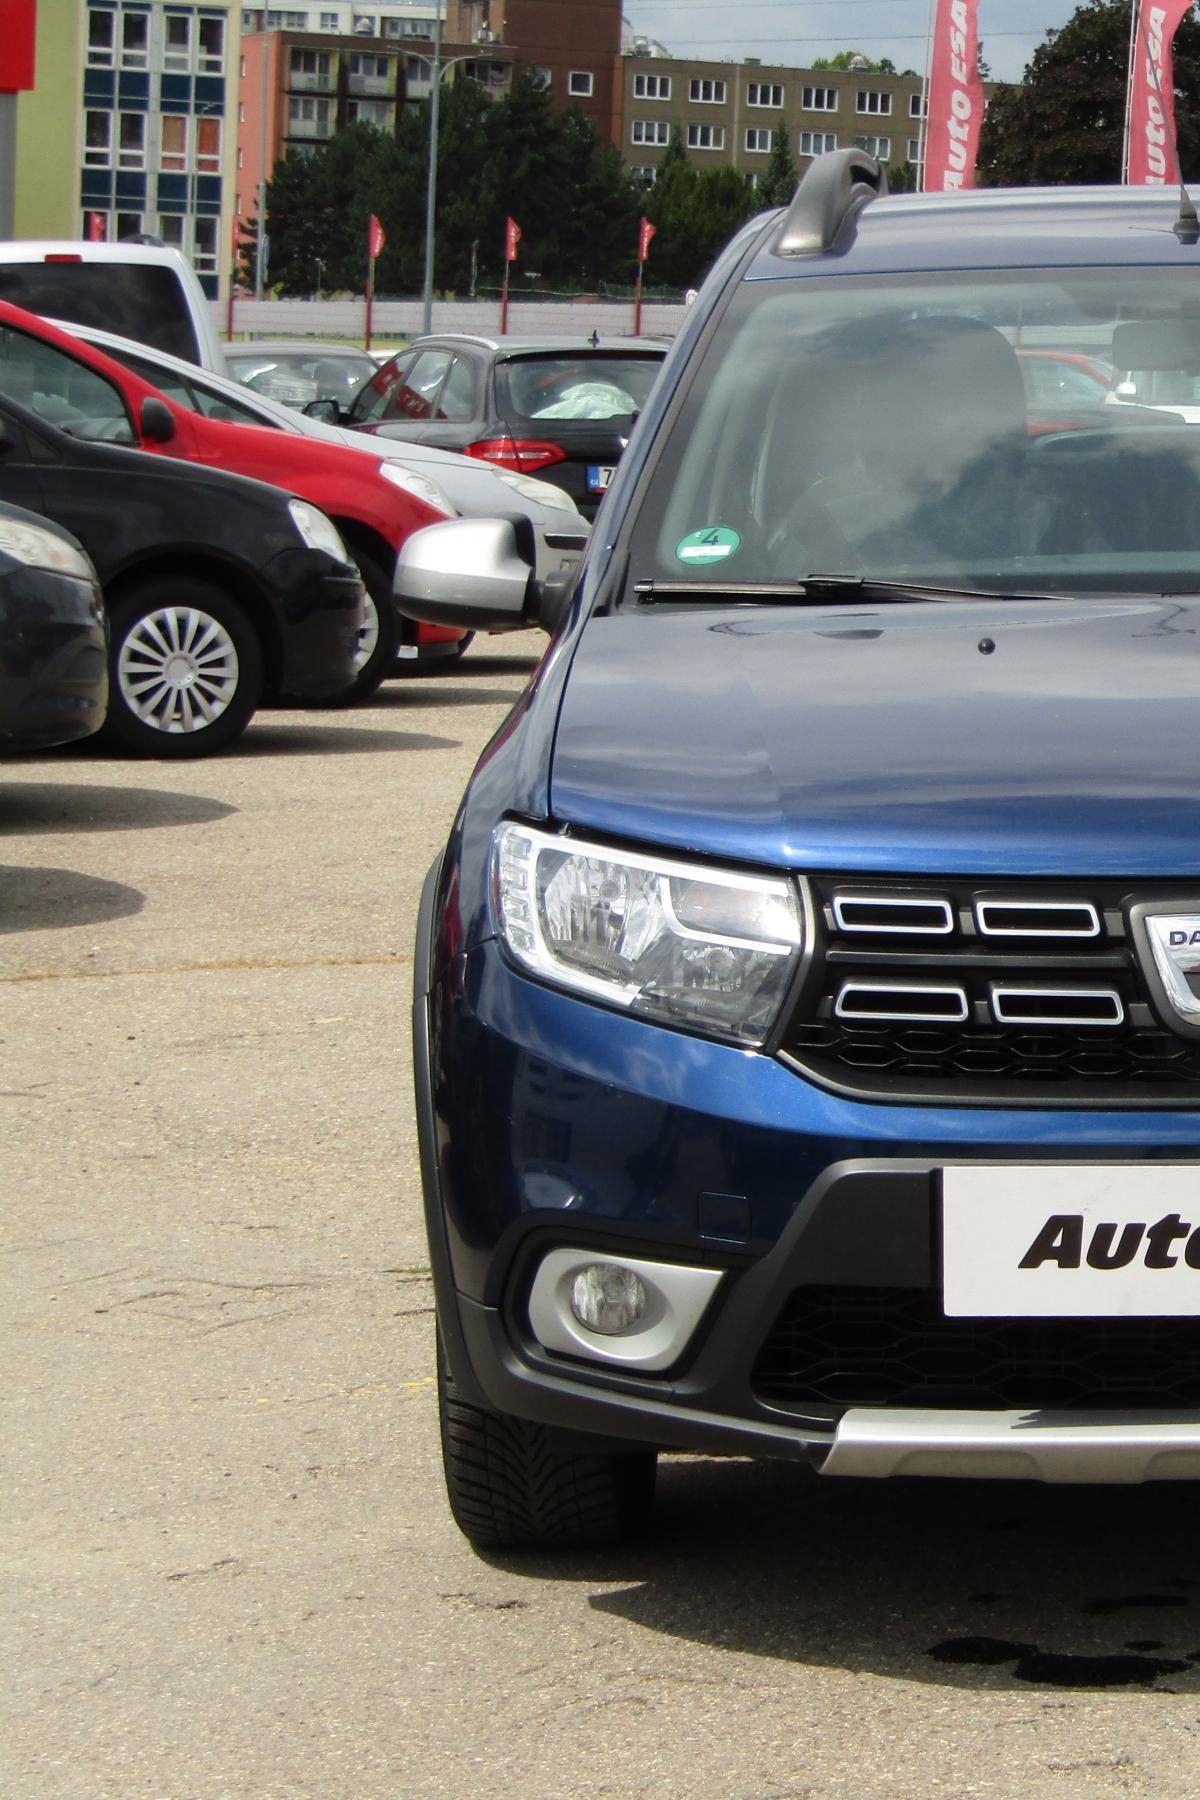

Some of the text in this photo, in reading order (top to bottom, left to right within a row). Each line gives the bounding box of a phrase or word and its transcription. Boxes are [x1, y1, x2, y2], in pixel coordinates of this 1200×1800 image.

[951, 0, 968, 86] ESA
[1145, 6, 1167, 185] uto ESA
